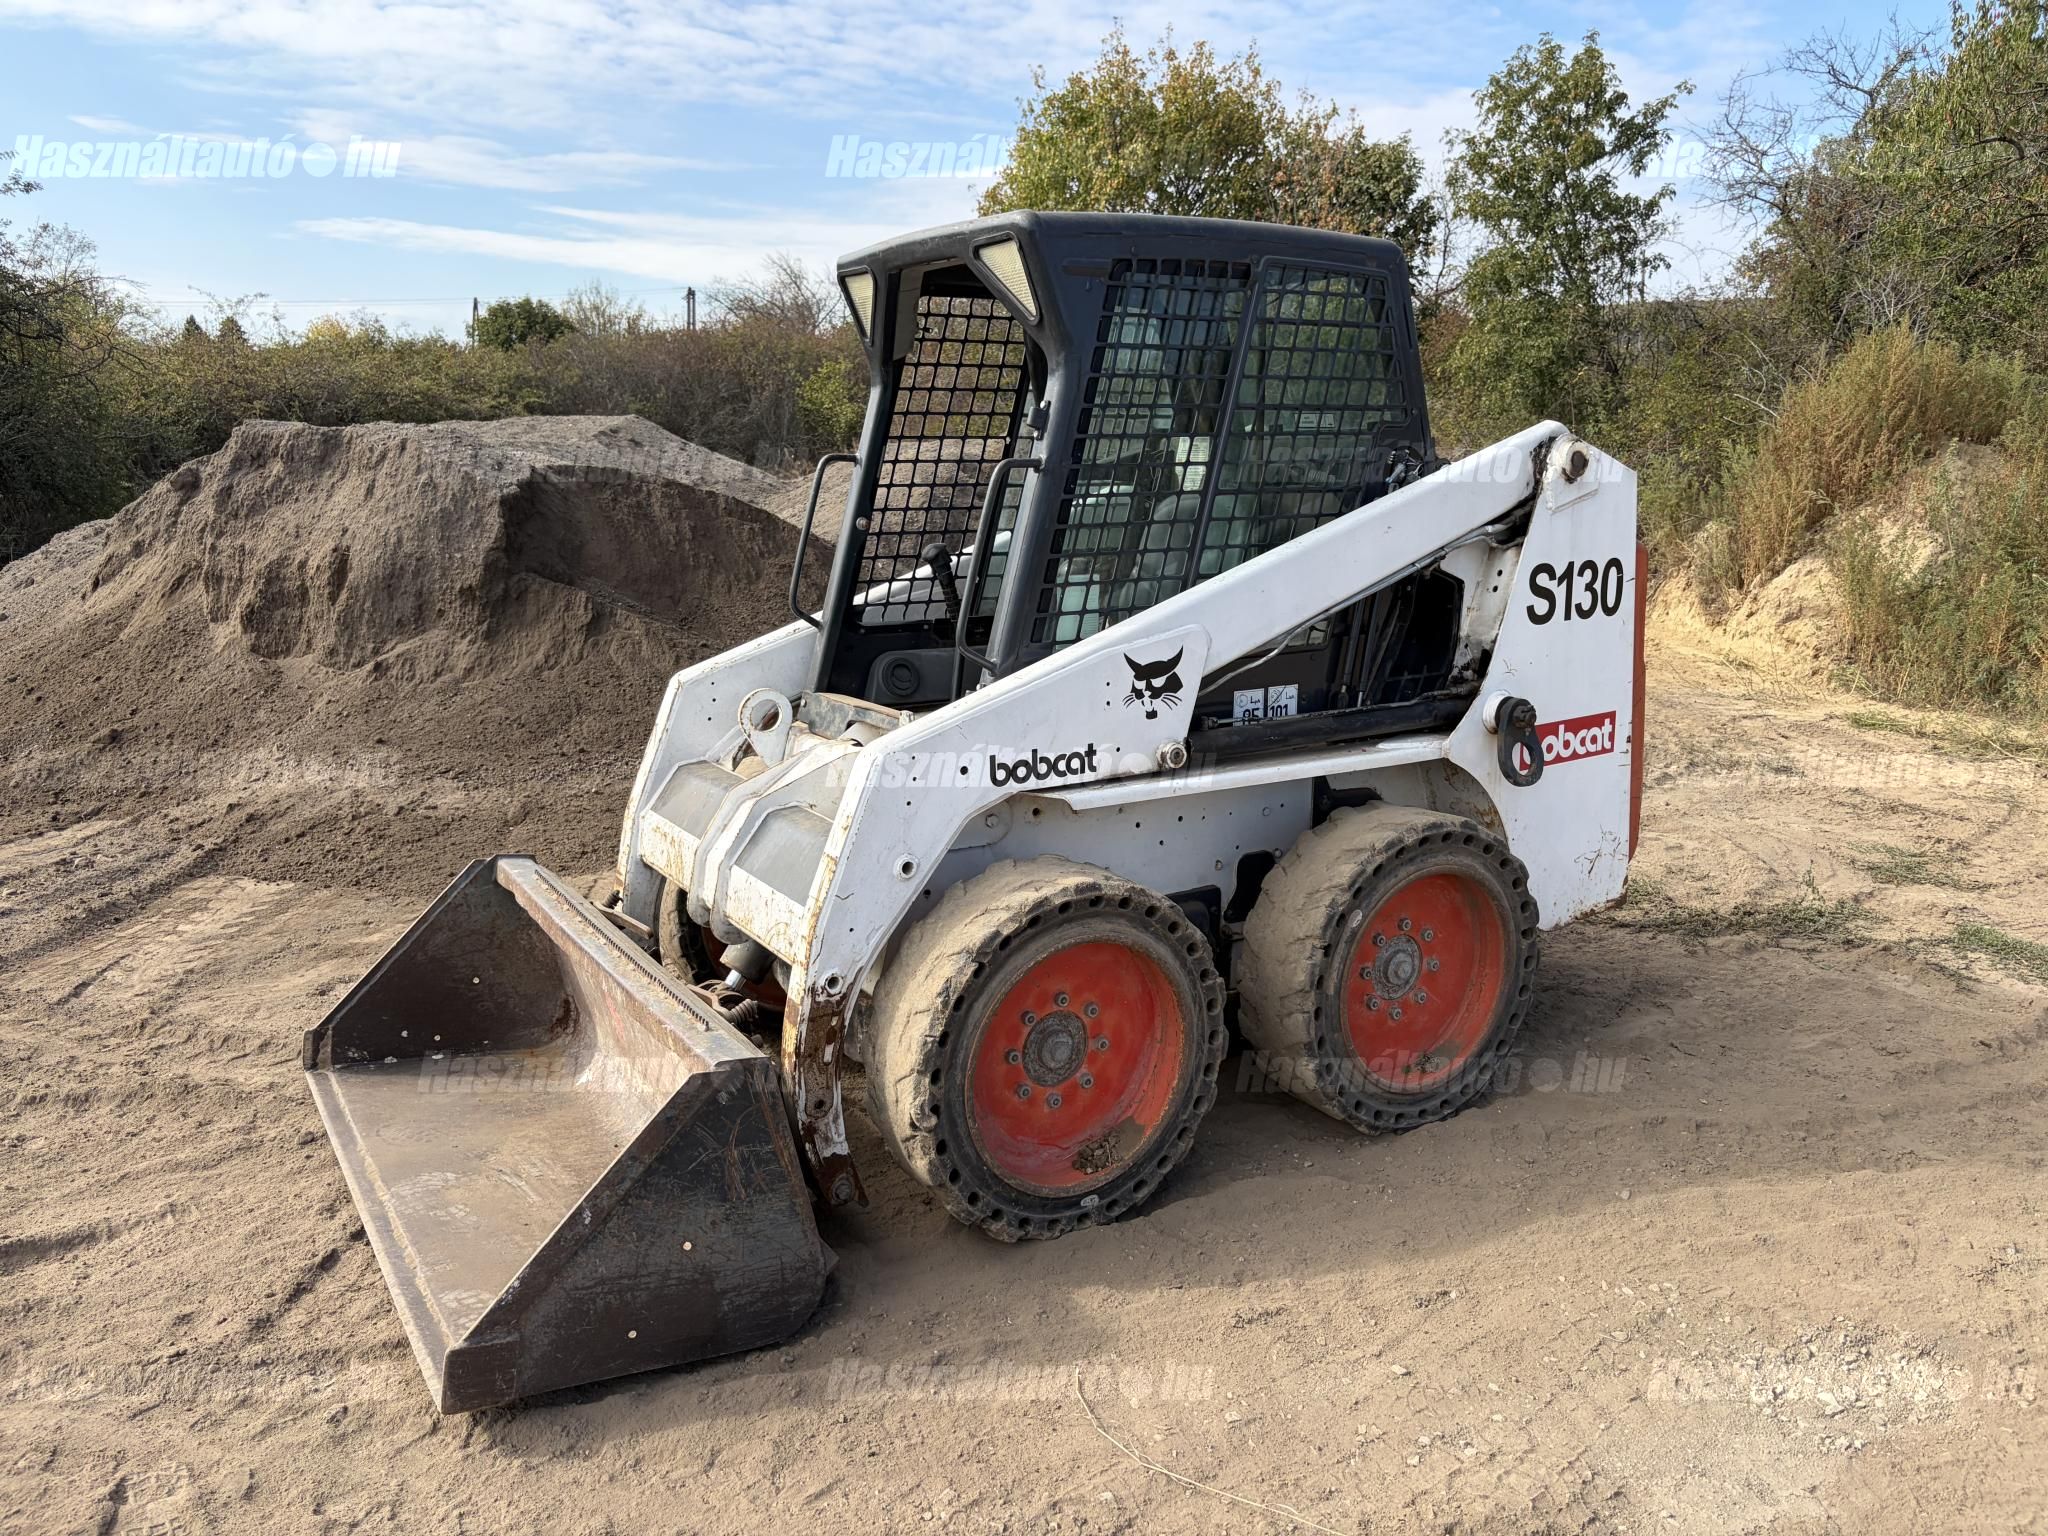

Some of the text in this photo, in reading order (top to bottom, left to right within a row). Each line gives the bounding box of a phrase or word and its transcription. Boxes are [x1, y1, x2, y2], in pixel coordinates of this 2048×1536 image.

[1526, 557, 1624, 626] S130
[1269, 703, 1289, 719] 101
[989, 742, 1098, 787] bobcat
